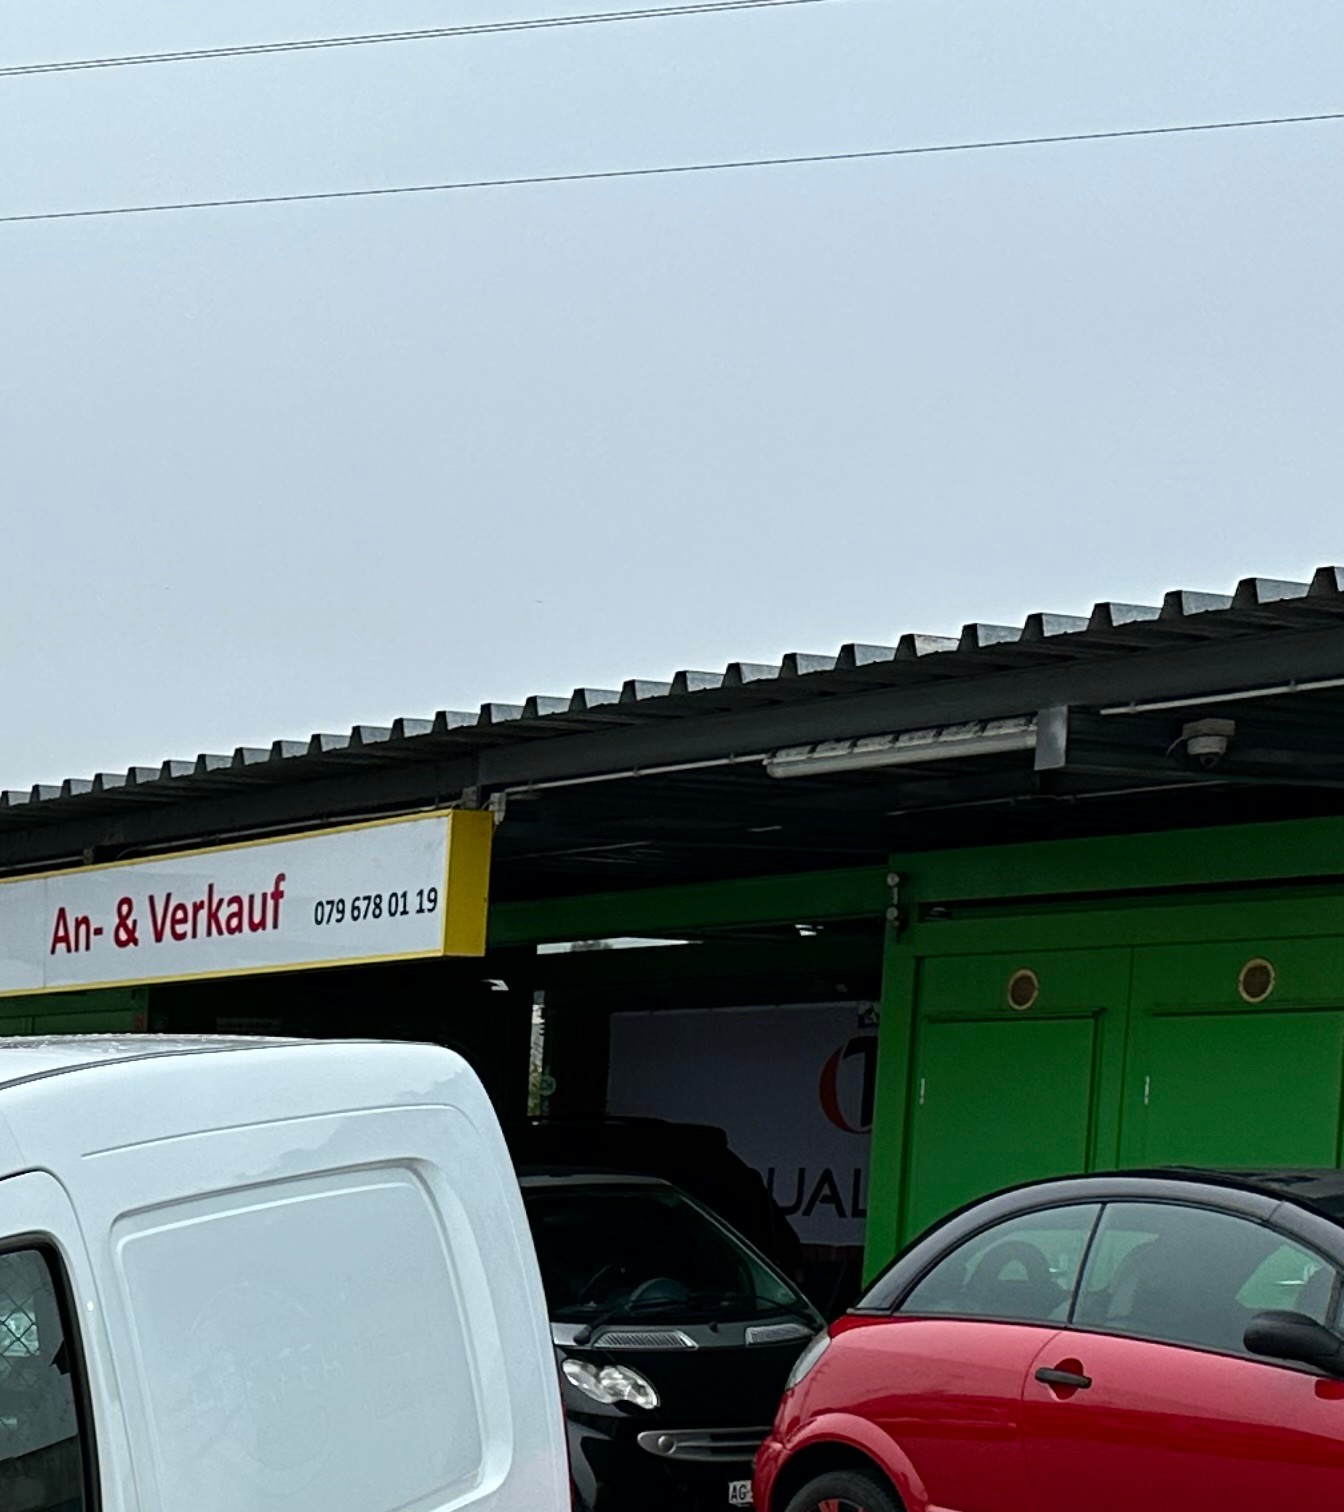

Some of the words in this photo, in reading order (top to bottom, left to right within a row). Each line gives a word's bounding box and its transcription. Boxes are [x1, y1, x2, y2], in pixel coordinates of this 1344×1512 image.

[50, 907, 103, 955] An-
[113, 896, 139, 949] &
[147, 873, 286, 944] Verkauf
[314, 899, 345, 926] 079
[350, 894, 382, 922] 678
[387, 890, 409, 917] 01
[415, 886, 438, 914] 19
